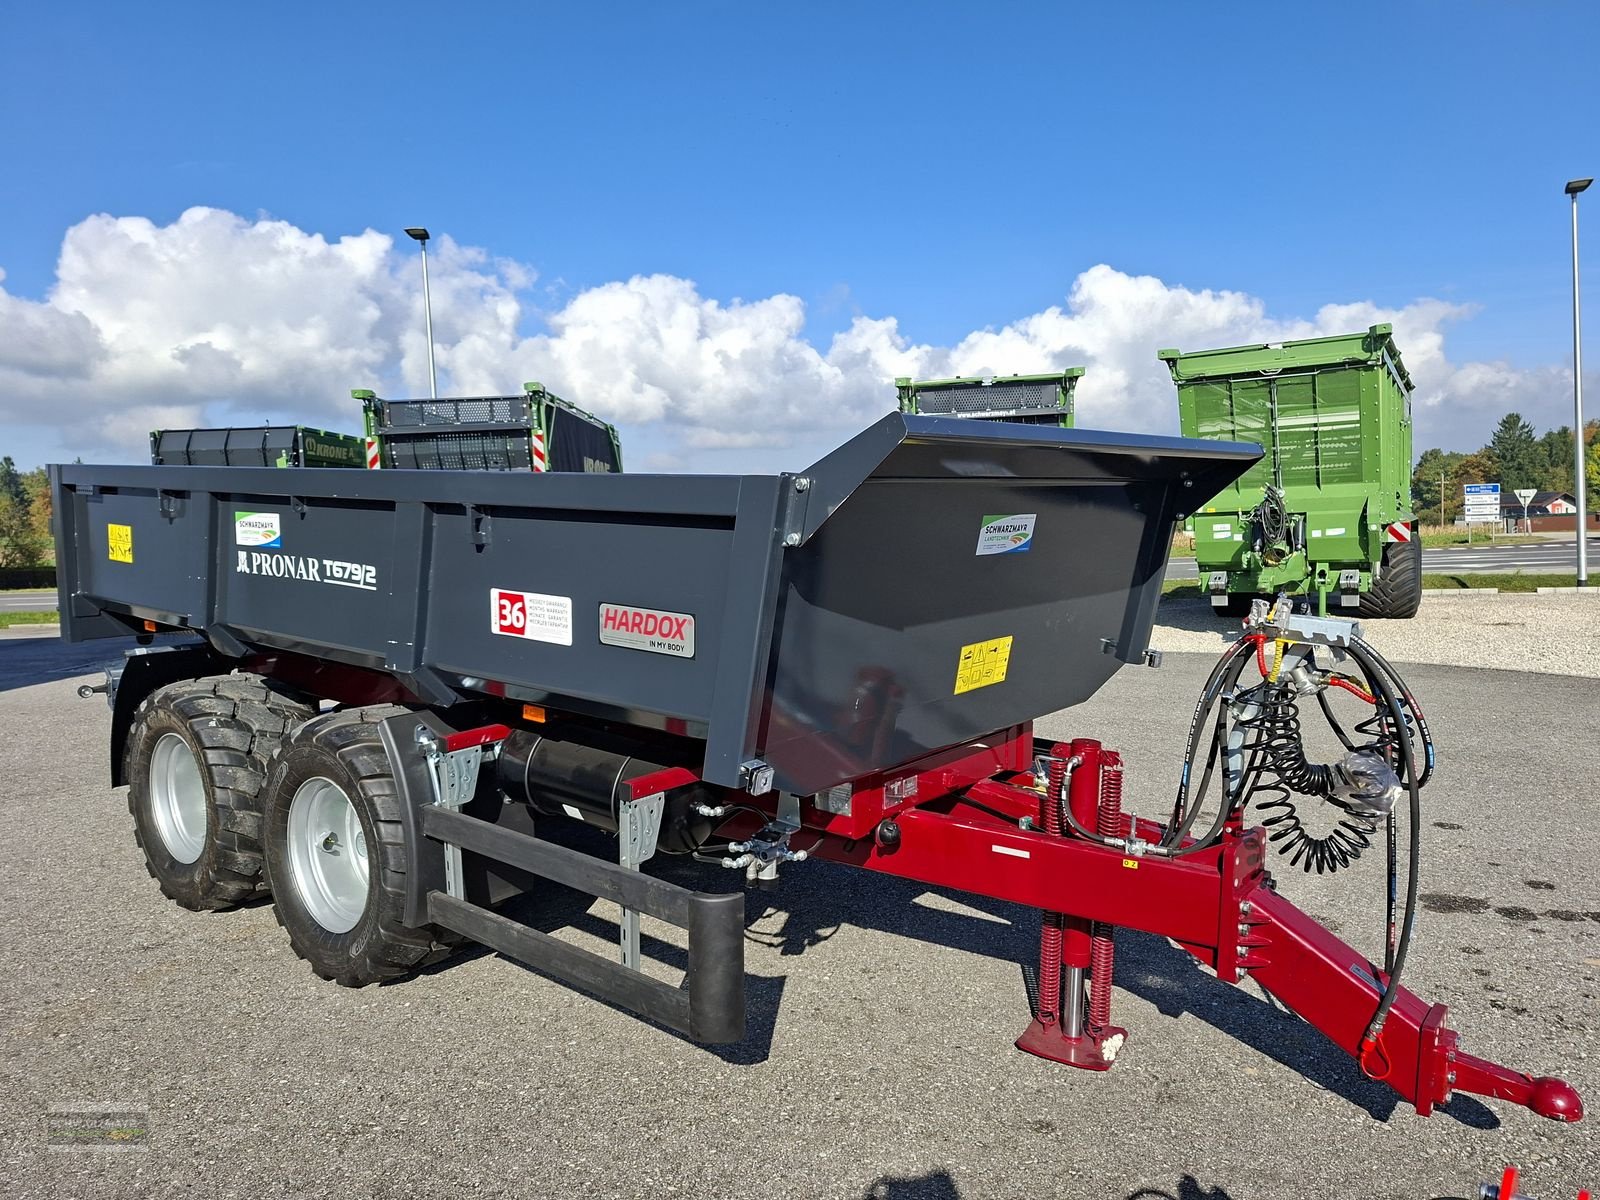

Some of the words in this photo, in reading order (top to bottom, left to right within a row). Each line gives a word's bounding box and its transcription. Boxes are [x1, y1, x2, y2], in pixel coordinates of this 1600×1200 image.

[316, 443, 348, 460] KRONE
[239, 520, 274, 529] SCHWARZMAYR
[985, 523, 1028, 534] SCHWARZMAYR
[251, 552, 321, 582] PRONAR
[323, 559, 376, 585] T679/2
[499, 598, 525, 629] 36
[603, 607, 687, 641] HARDOX
[649, 640, 656, 648] IN
[656, 641, 667, 650] MY
[667, 643, 685, 652] BODY
